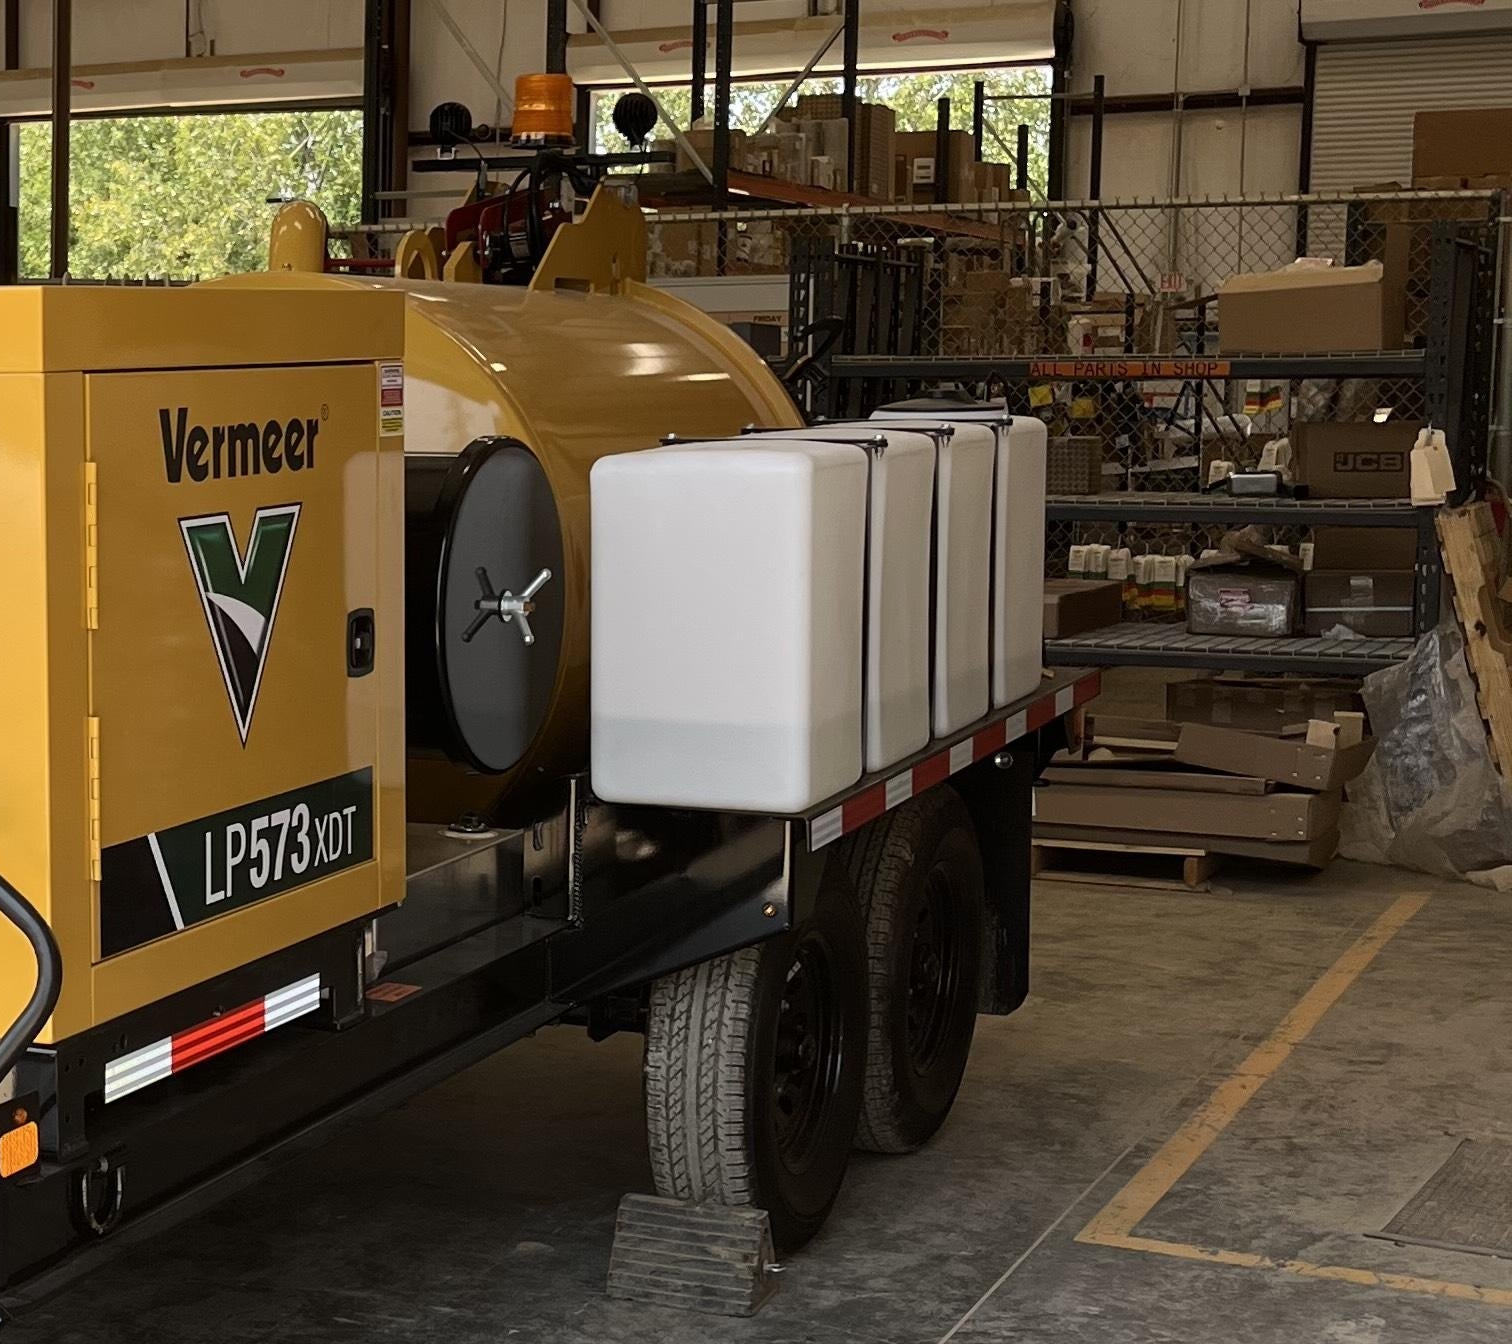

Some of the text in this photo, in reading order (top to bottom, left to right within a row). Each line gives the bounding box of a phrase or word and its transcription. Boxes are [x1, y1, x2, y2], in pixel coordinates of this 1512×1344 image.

[1160, 272, 1184, 290] EXIT
[1031, 361, 1218, 376] ALL PARTS IN SHOP
[159, 407, 319, 483] Vermeer
[1335, 454, 1403, 470] JCB
